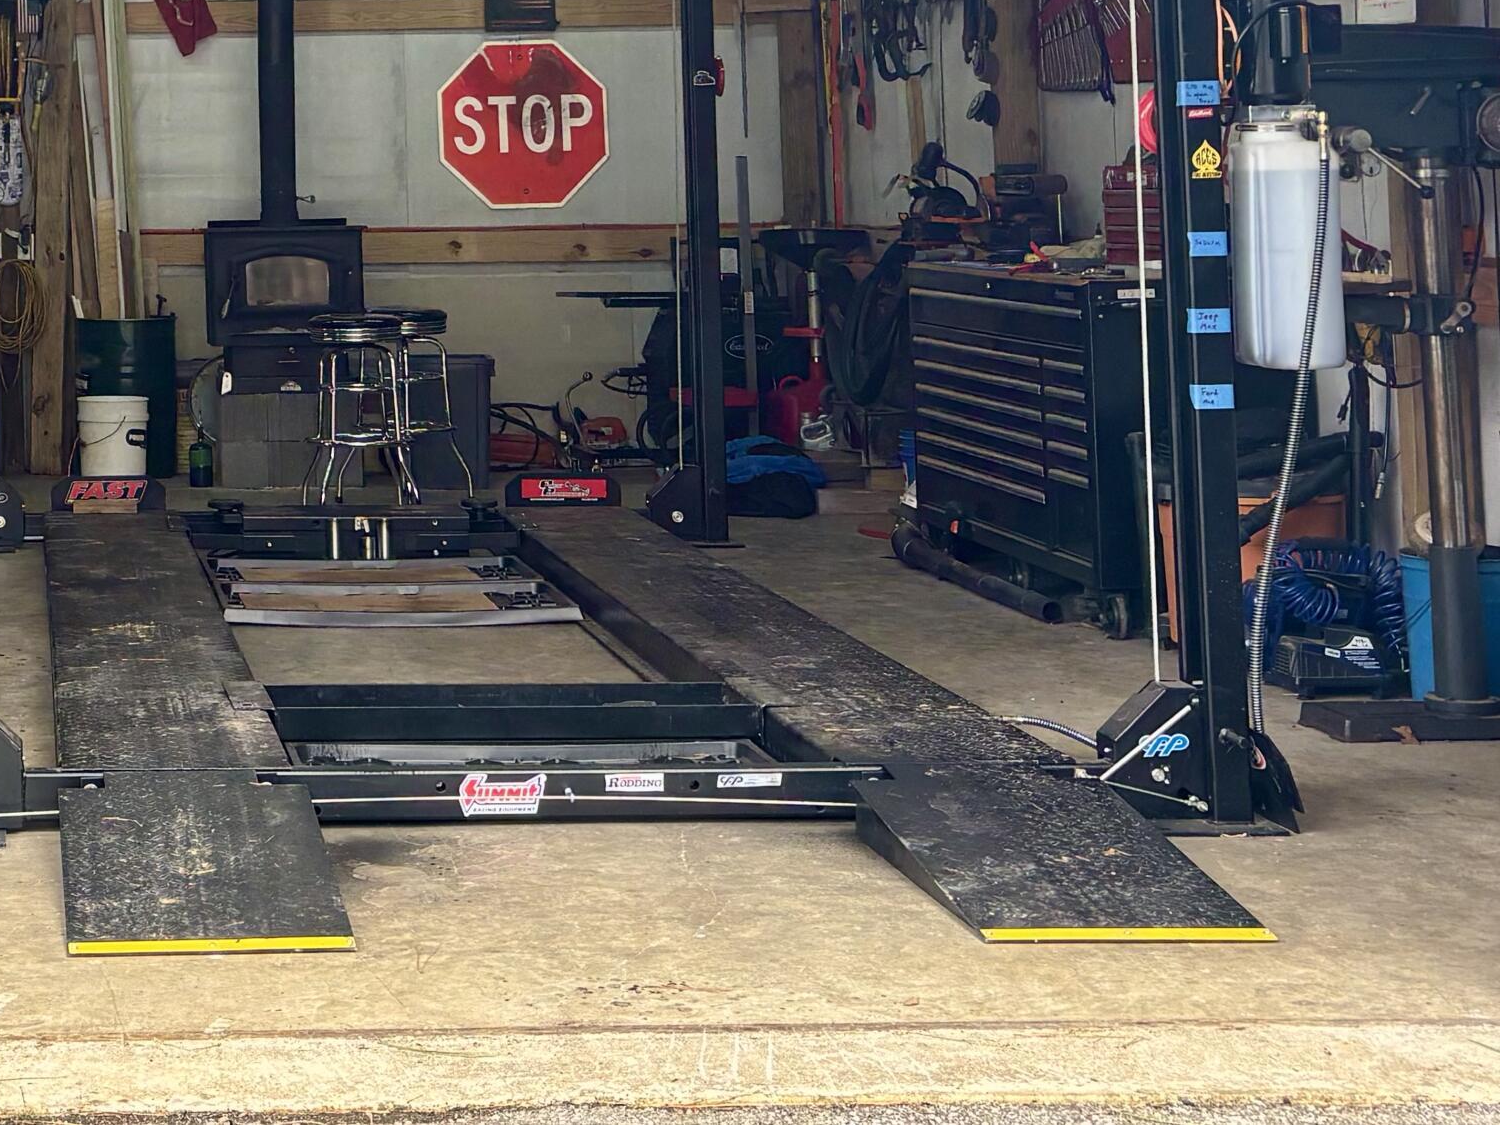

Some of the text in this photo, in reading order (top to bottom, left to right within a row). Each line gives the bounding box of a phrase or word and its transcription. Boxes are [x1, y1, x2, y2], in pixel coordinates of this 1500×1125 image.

[454, 94, 593, 155] STOP
[1195, 147, 1218, 166] ACES
[1196, 313, 1219, 323] Jeep
[69, 481, 144, 500] FAST
[609, 777, 662, 787] RODDING
[464, 778, 539, 807] SUMMIT
